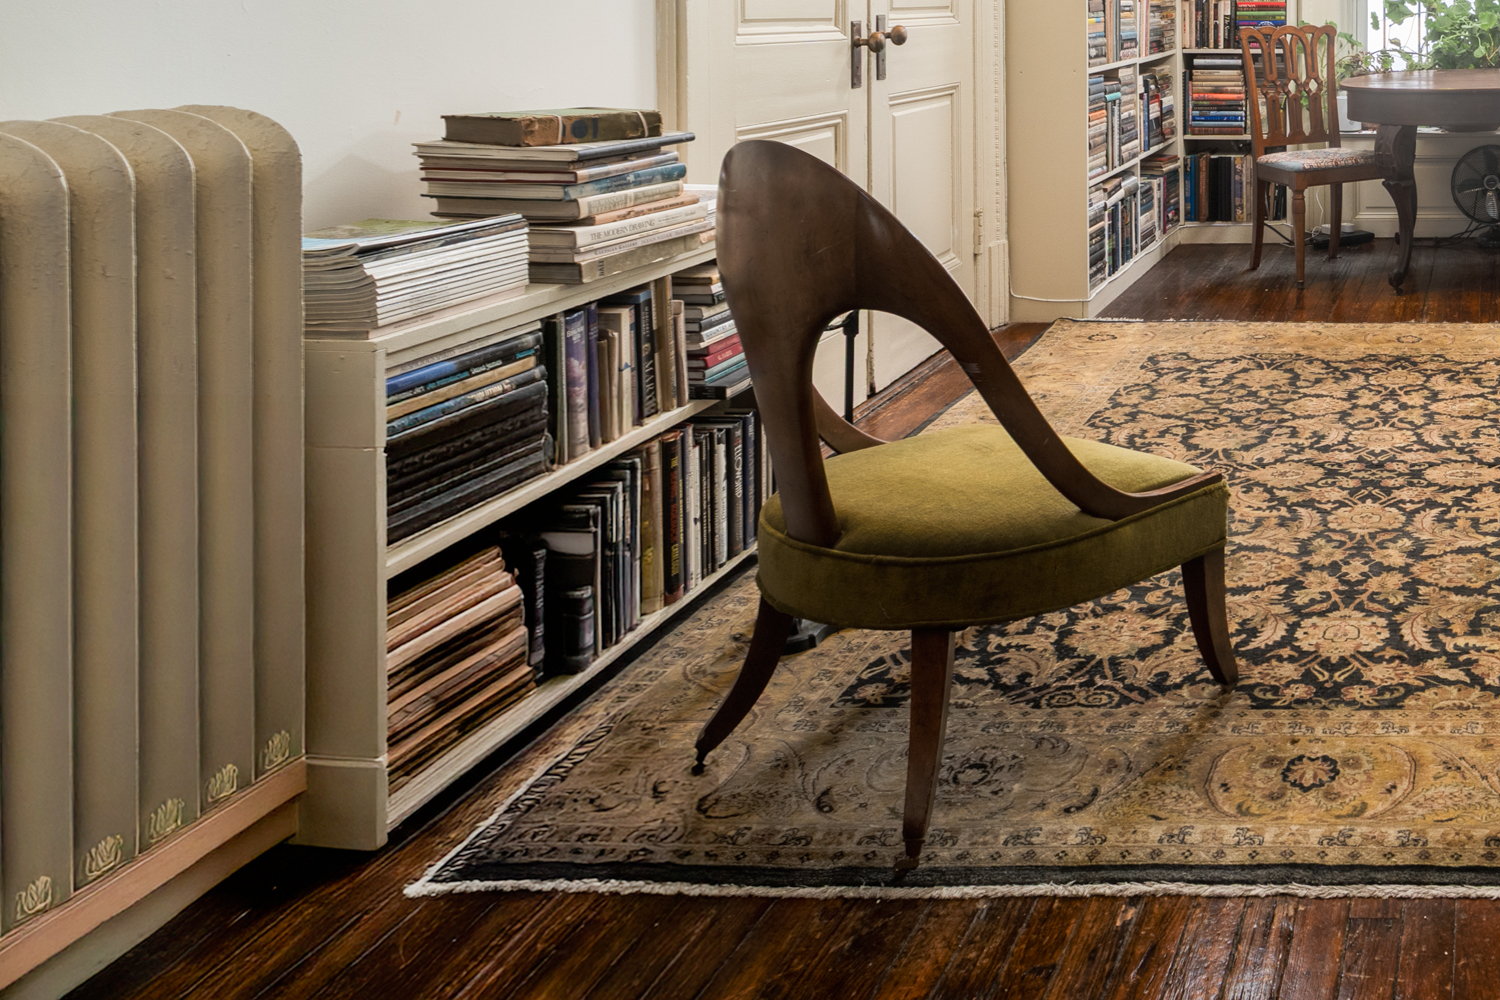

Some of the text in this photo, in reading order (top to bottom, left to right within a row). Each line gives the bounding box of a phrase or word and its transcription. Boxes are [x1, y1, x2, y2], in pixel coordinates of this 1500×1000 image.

[590, 220, 655, 242] THE MODERN DRAWING
[618, 241, 638, 250] GALLERY
[705, 325, 727, 338] COUNTRY
[670, 456, 678, 468] THE
[671, 543, 679, 577] CATALOGUE
